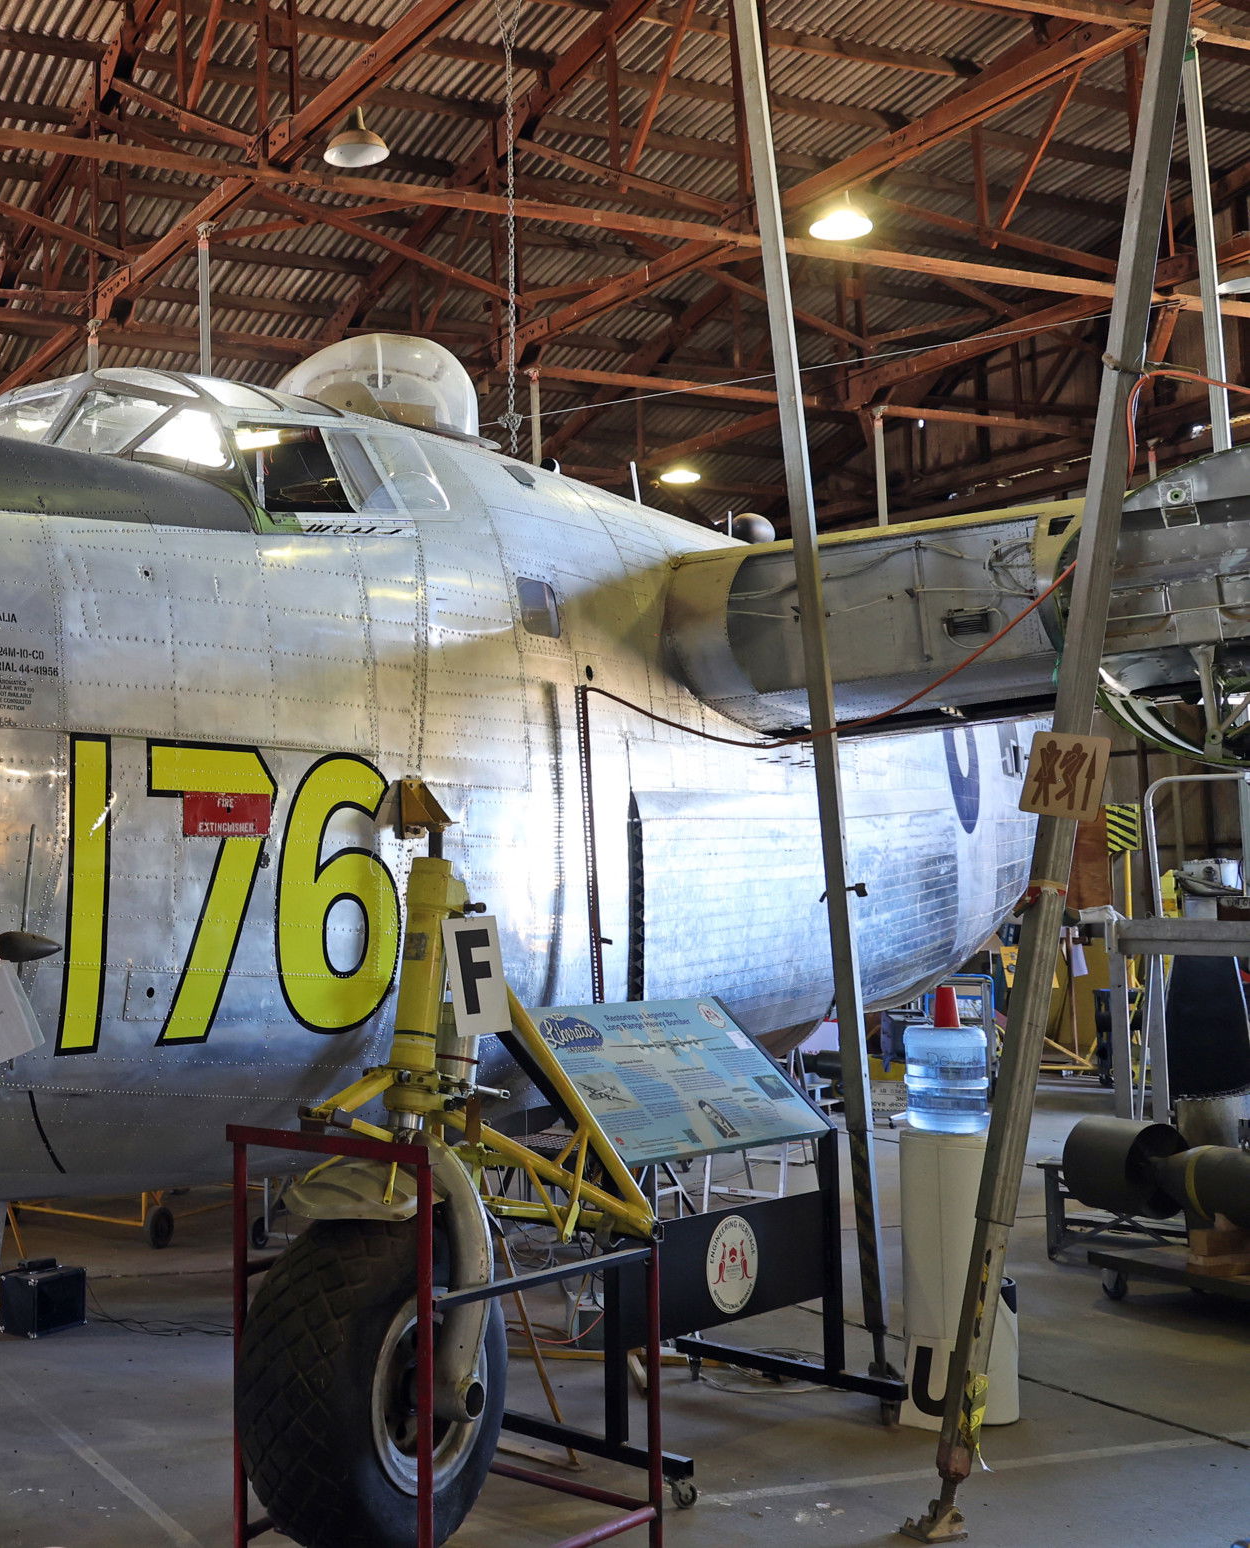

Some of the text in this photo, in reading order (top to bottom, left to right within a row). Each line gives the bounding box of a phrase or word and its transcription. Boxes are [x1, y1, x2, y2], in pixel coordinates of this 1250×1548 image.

[18, 663, 59, 677] 44-41956
[217, 798, 235, 808] FIRE
[198, 821, 255, 833] EXTINGUISHER
[54, 733, 401, 1057] 176
[454, 928, 492, 1015] F
[543, 1019, 600, 1048] Liberator
[709, 1220, 738, 1264] ENGINEERING
